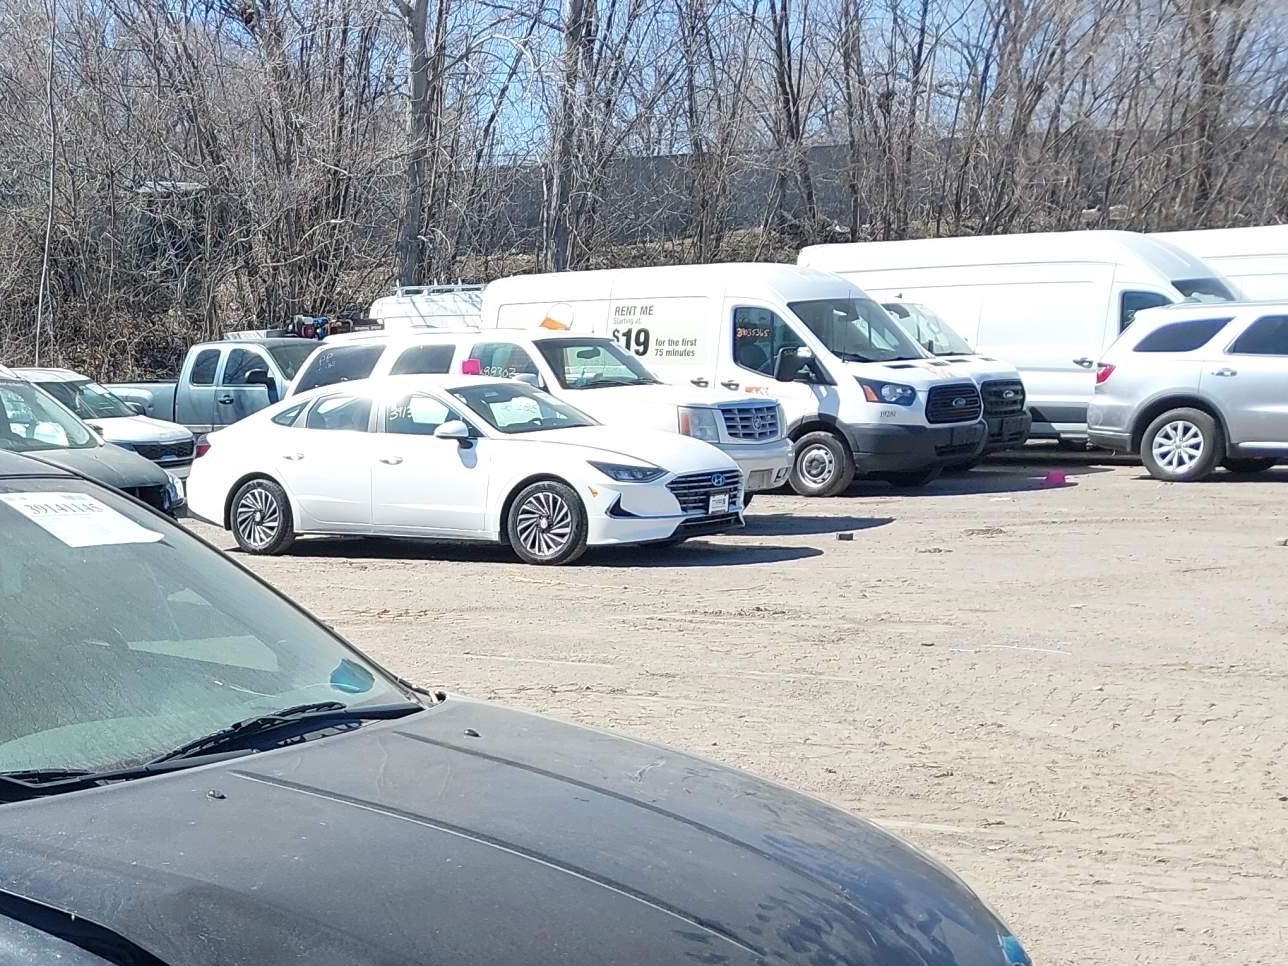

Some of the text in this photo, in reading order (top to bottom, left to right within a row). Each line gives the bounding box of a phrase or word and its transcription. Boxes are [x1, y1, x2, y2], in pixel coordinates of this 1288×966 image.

[615, 304, 654, 316] RENT ME
[612, 327, 650, 357] $19
[655, 337, 697, 347] for the first
[654, 348, 696, 357] 75 minutes
